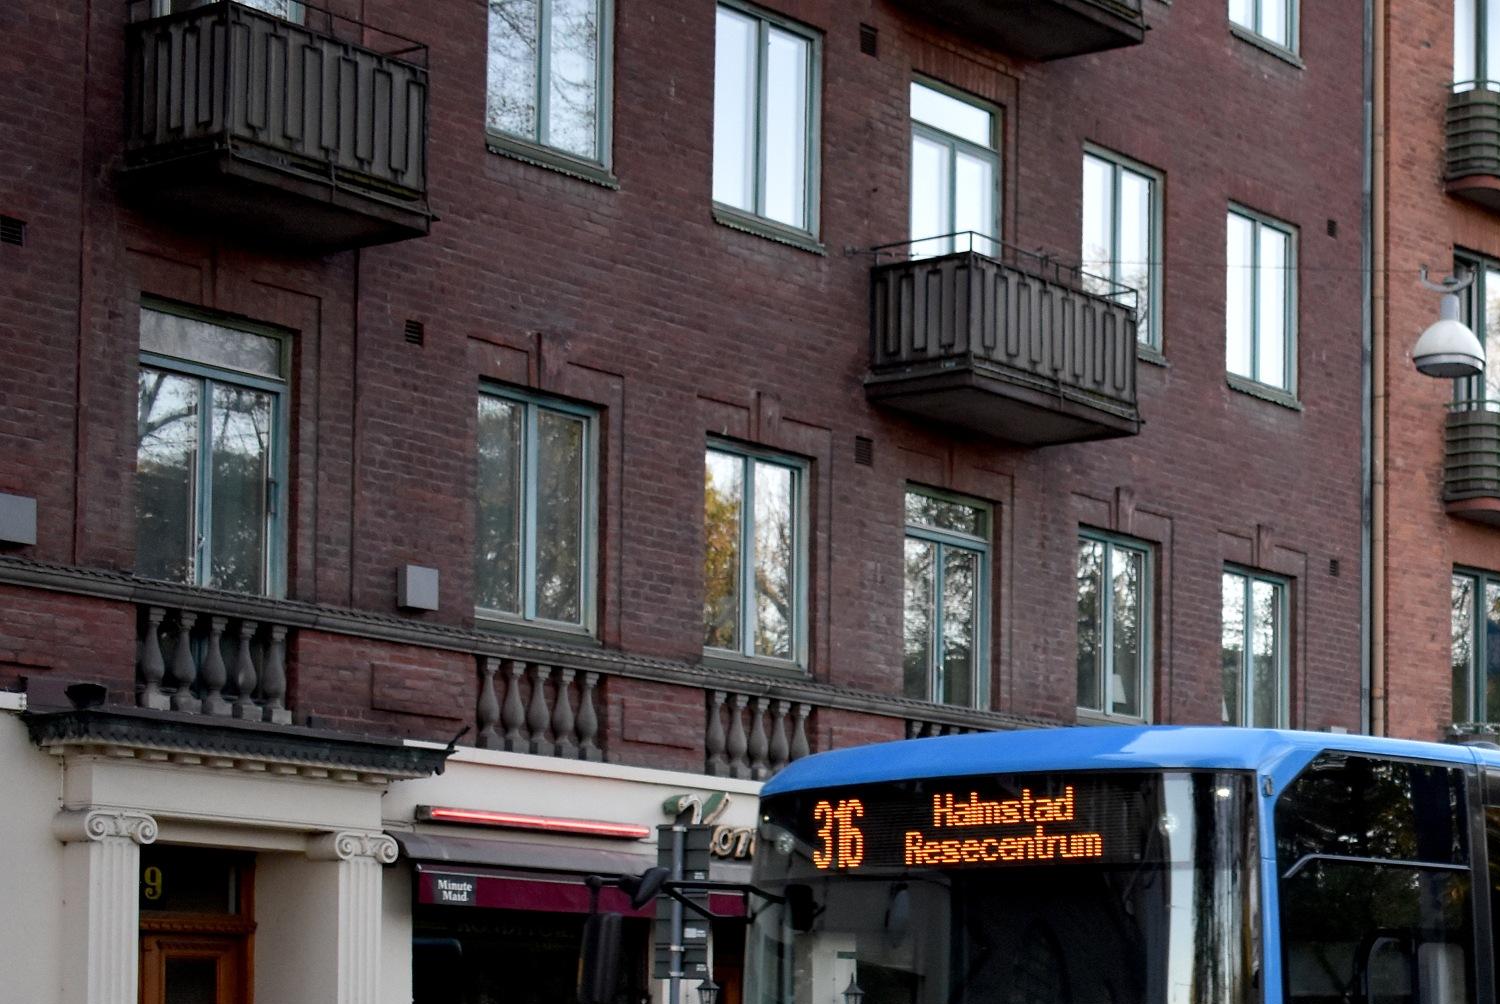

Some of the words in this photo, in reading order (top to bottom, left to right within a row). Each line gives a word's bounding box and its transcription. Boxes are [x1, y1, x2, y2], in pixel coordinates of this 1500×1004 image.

[933, 786, 1074, 827] Halmstad
[905, 825, 1102, 865] Resecentrum
[144, 866, 162, 900] 9
[437, 879, 473, 892] Minute
[442, 890, 468, 902] Maid
